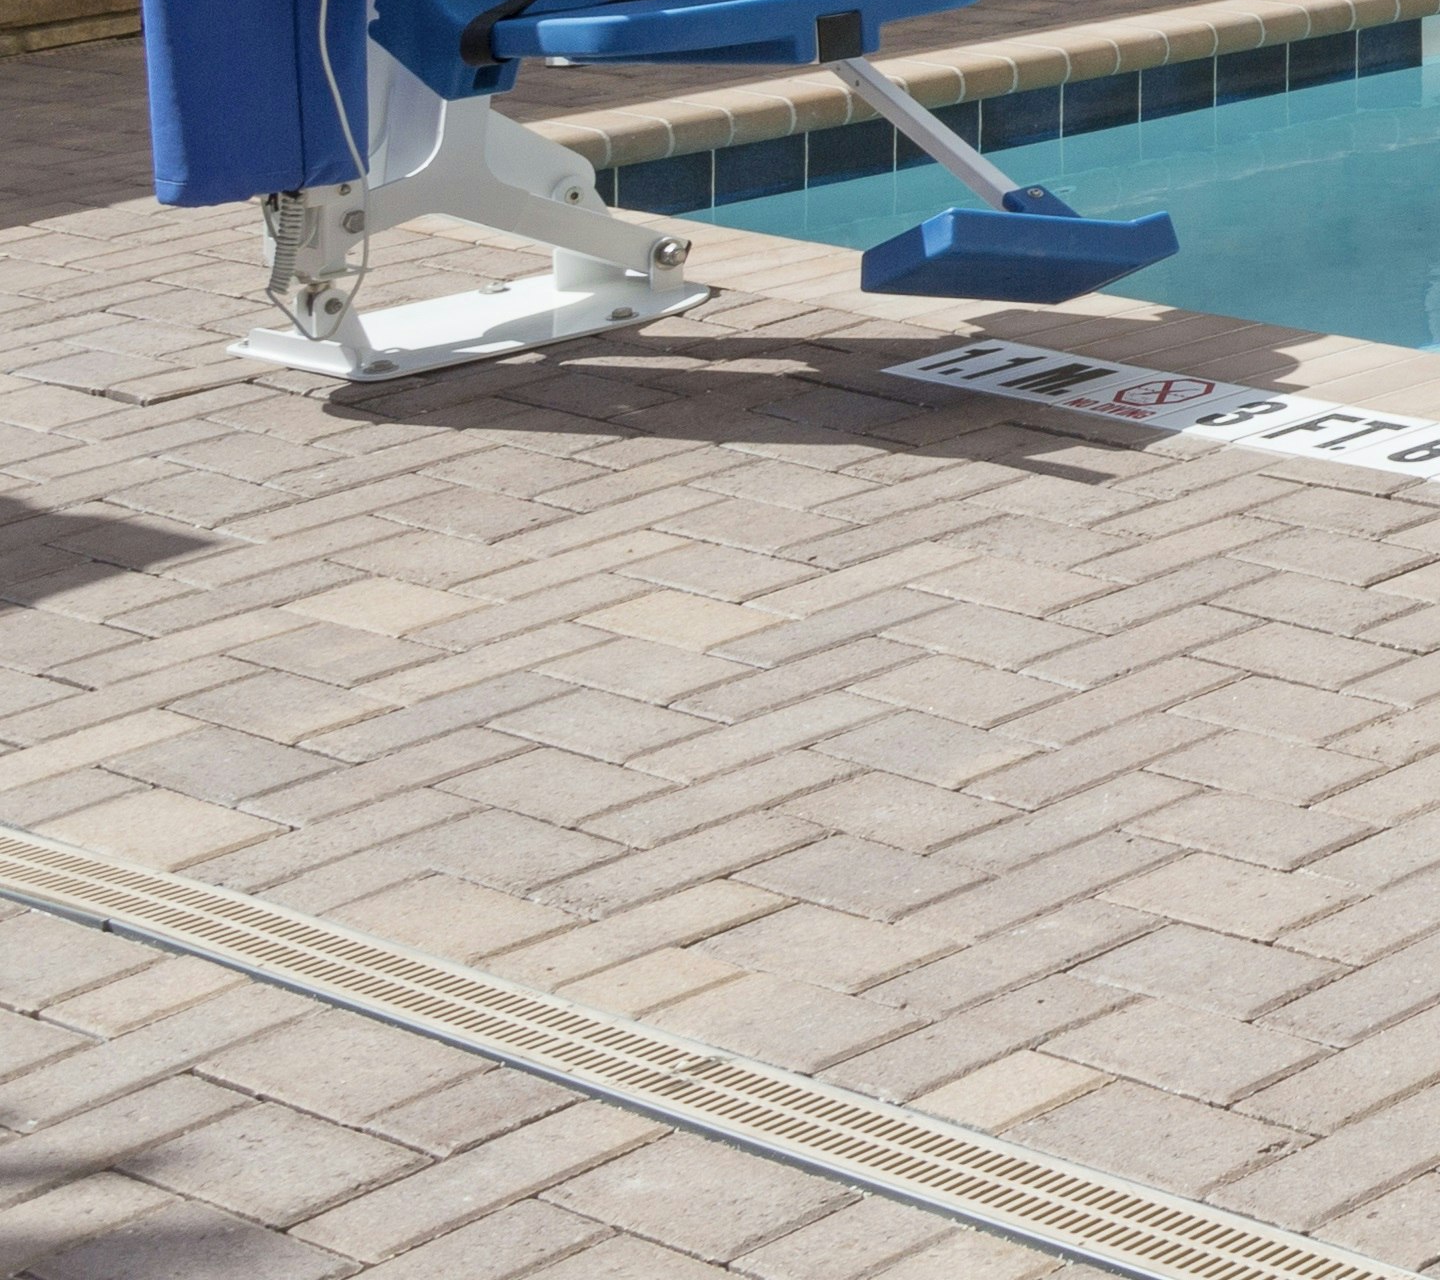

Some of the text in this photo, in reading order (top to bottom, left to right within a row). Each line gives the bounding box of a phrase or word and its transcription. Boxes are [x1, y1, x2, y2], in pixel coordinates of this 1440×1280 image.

[918, 347, 1047, 380] 1.1
[1195, 400, 1288, 427] 3
[1063, 397, 1156, 419] NO DIVING
